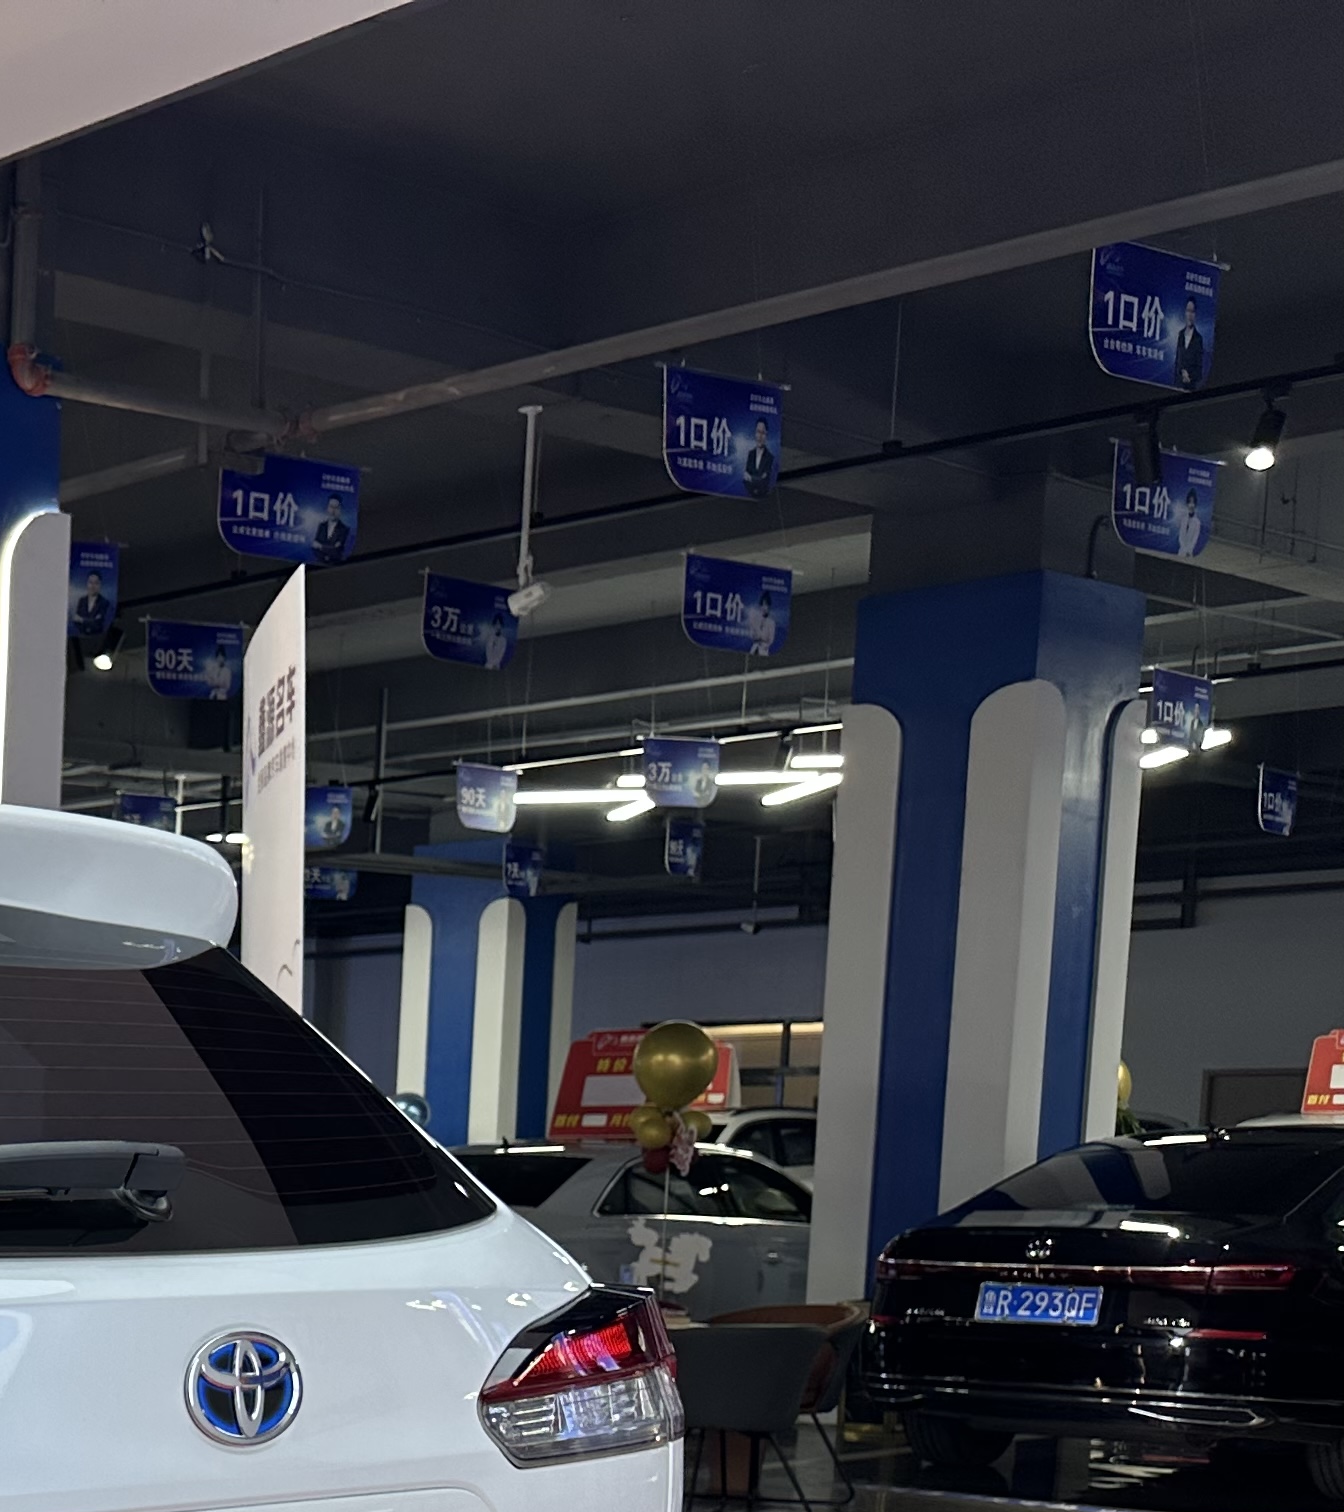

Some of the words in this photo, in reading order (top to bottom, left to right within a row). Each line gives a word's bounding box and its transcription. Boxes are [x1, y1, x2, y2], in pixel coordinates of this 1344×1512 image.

[1103, 290, 1165, 341] 1口价
[676, 415, 732, 457] 1口价
[232, 488, 299, 528] 1口价
[1123, 483, 1171, 520] 1口价
[693, 590, 744, 623] 1口价
[154, 648, 194, 672] 90天
